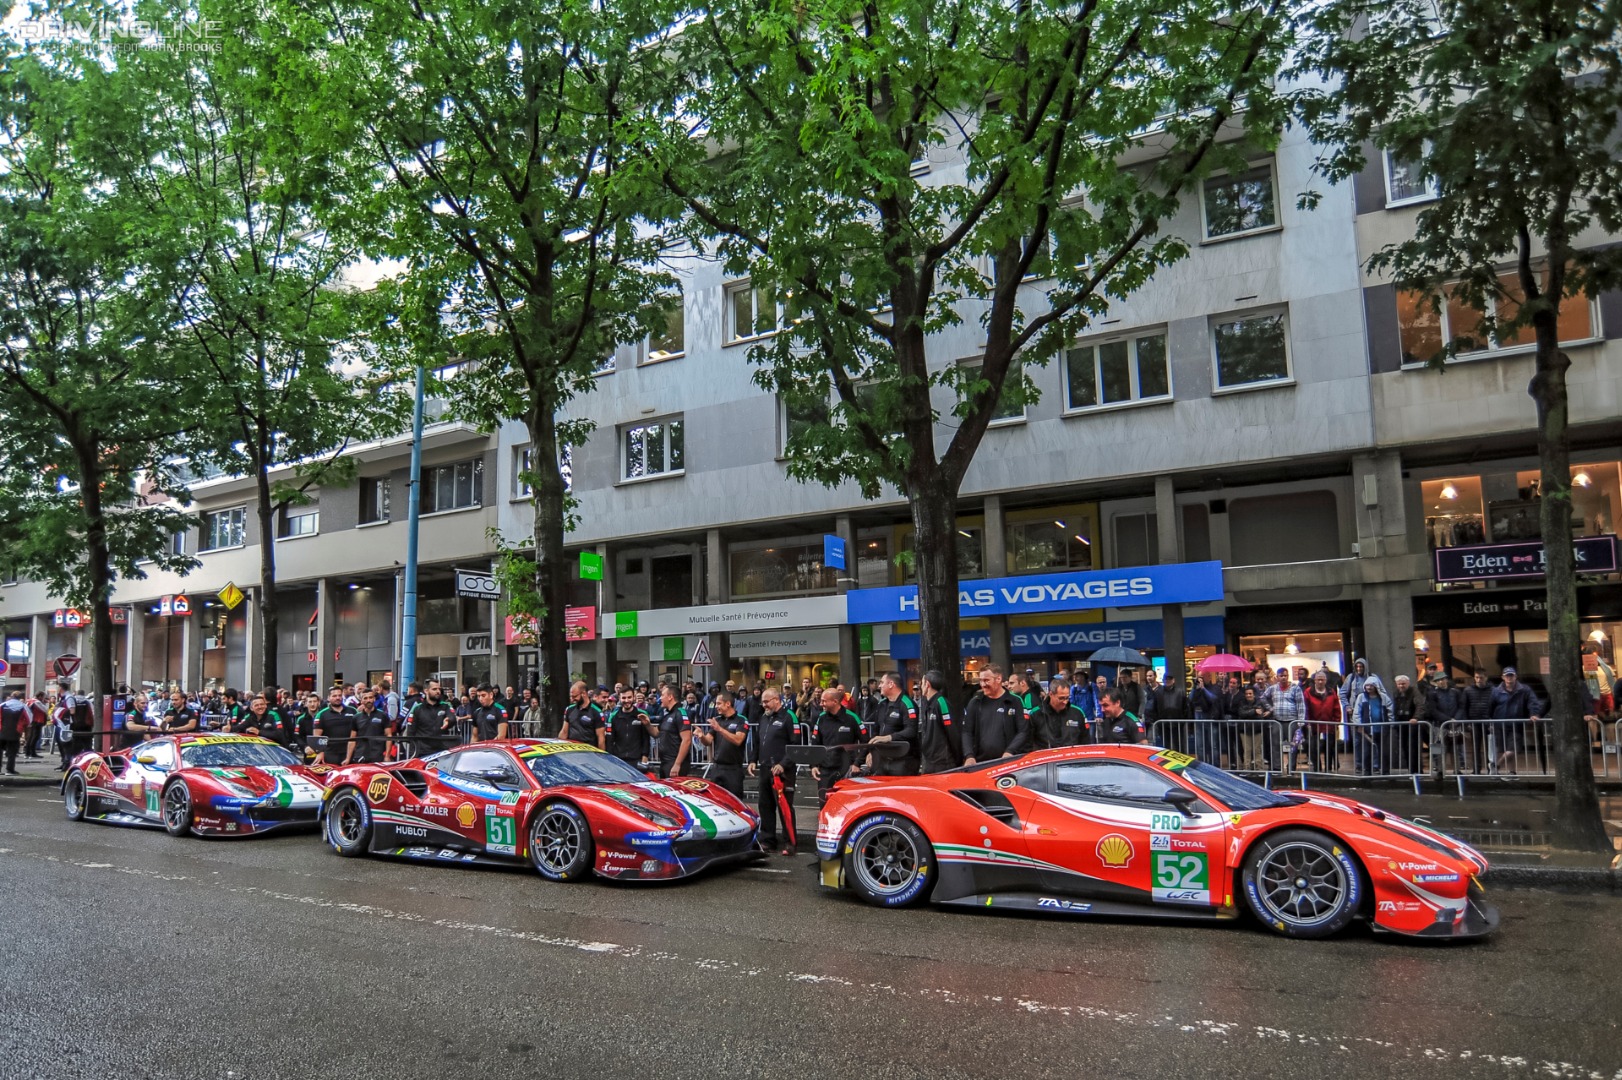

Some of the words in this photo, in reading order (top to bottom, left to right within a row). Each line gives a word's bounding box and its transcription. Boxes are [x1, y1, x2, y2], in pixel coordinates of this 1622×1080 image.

[582, 563, 599, 574] mgen
[1461, 554, 1508, 569] Eden
[1469, 567, 1513, 575] RUGBY
[899, 588, 995, 612] HAS
[1001, 577, 1153, 604] VOYAGES
[1463, 602, 1499, 613] Eden
[689, 614, 720, 624] Mutuelle
[721, 612, 742, 622] Santé
[746, 610, 789, 621] Prévoyance
[616, 619, 634, 632] mgen
[748, 640, 767, 649] Santé
[770, 639, 808, 648] Prévoyance
[1032, 628, 1136, 645] VOYAGES
[370, 782, 388, 799] ups
[501, 792, 520, 804] PRO
[146, 791, 159, 810] 71
[423, 805, 449, 817] ADLER
[851, 815, 883, 841] MICHELIN
[1151, 814, 1182, 830] PRO
[395, 825, 428, 838] HUBLOT
[490, 817, 512, 844] 51
[607, 851, 637, 860] V-Power
[1157, 854, 1204, 889] 52
[1398, 861, 1437, 870] V-Power
[1342, 860, 1357, 900] MICHELIN
[888, 881, 921, 904] MICHELIN
[1248, 884, 1273, 920] MICHELIN
